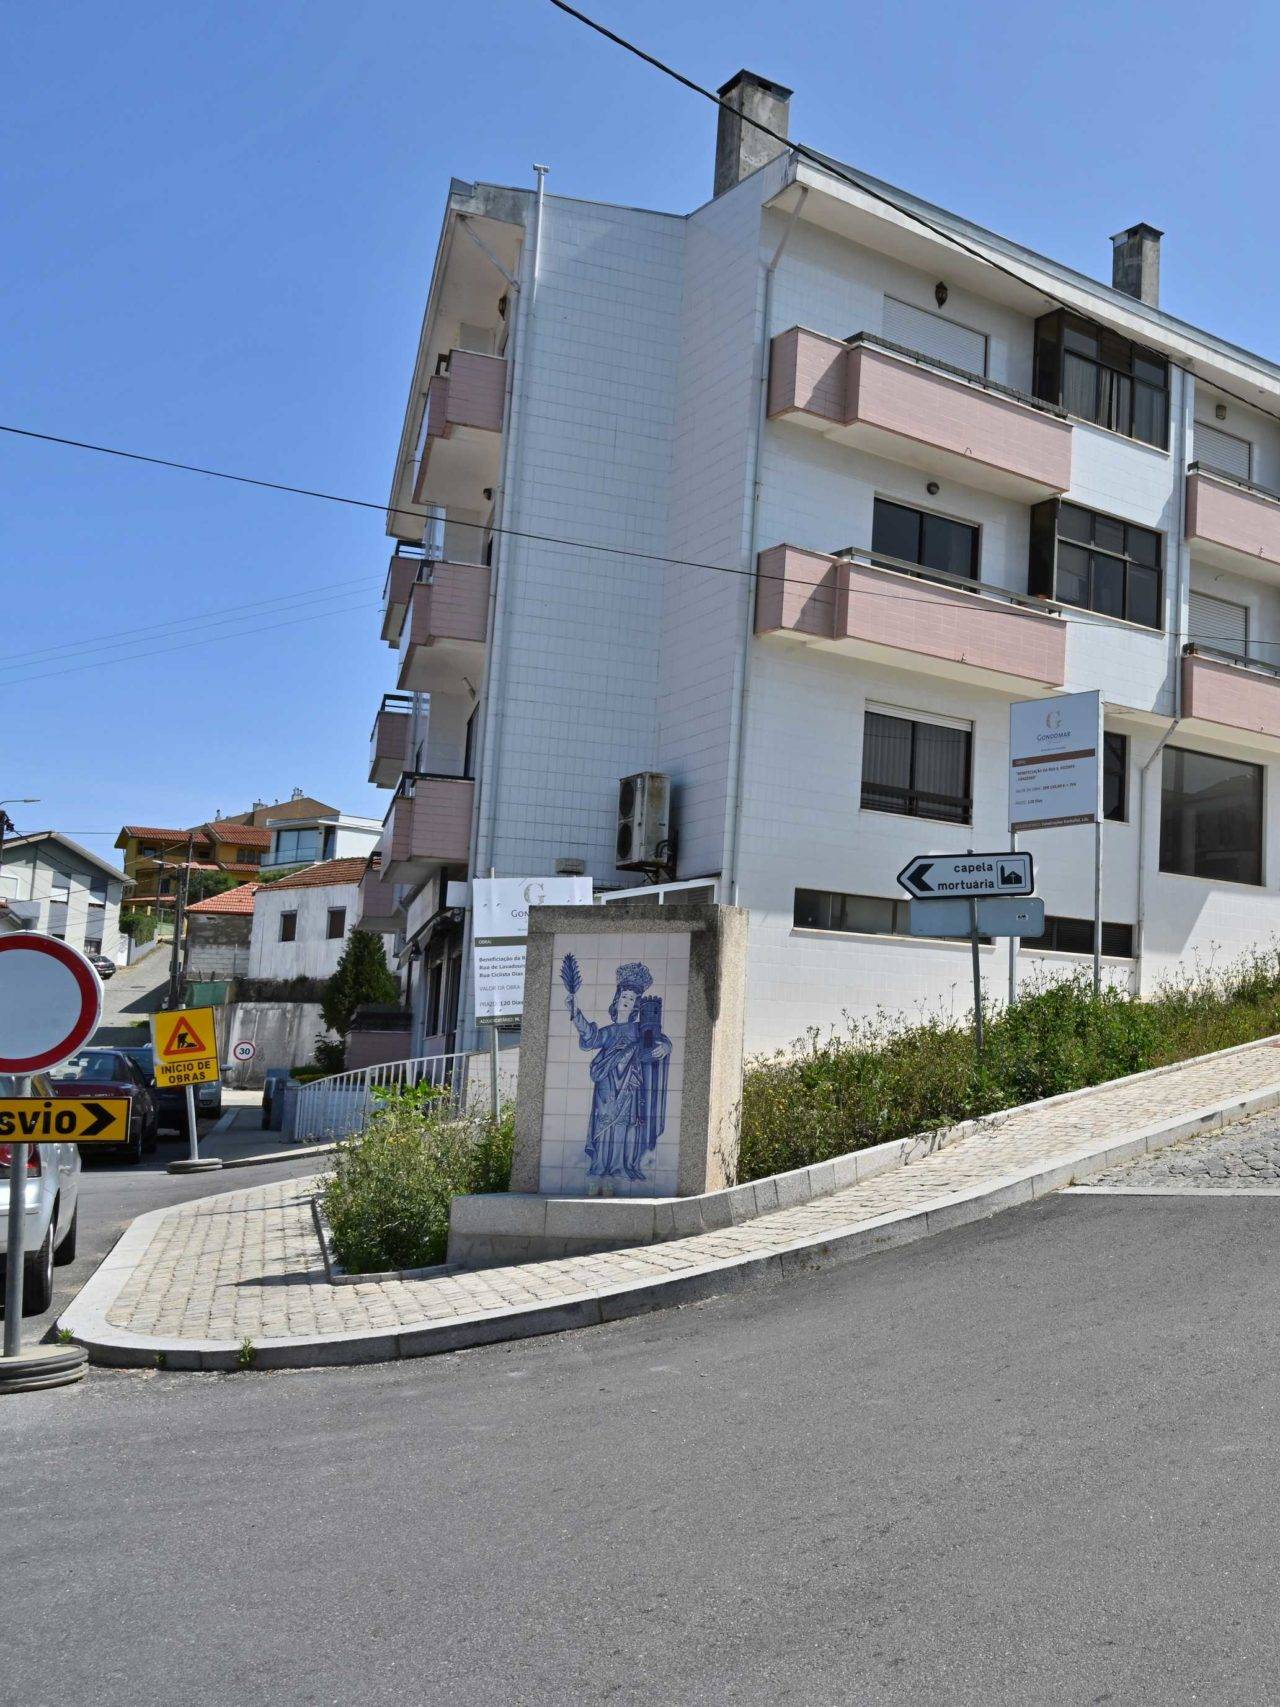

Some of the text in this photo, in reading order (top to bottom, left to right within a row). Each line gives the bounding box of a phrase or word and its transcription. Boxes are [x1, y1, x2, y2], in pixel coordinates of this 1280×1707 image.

[953, 862, 993, 874] capela
[239, 1047, 251, 1055] 30
[161, 1060, 211, 1074] INÍCIO DE
[168, 1072, 206, 1084] OBRAS
[0, 1101, 77, 1136] svio
